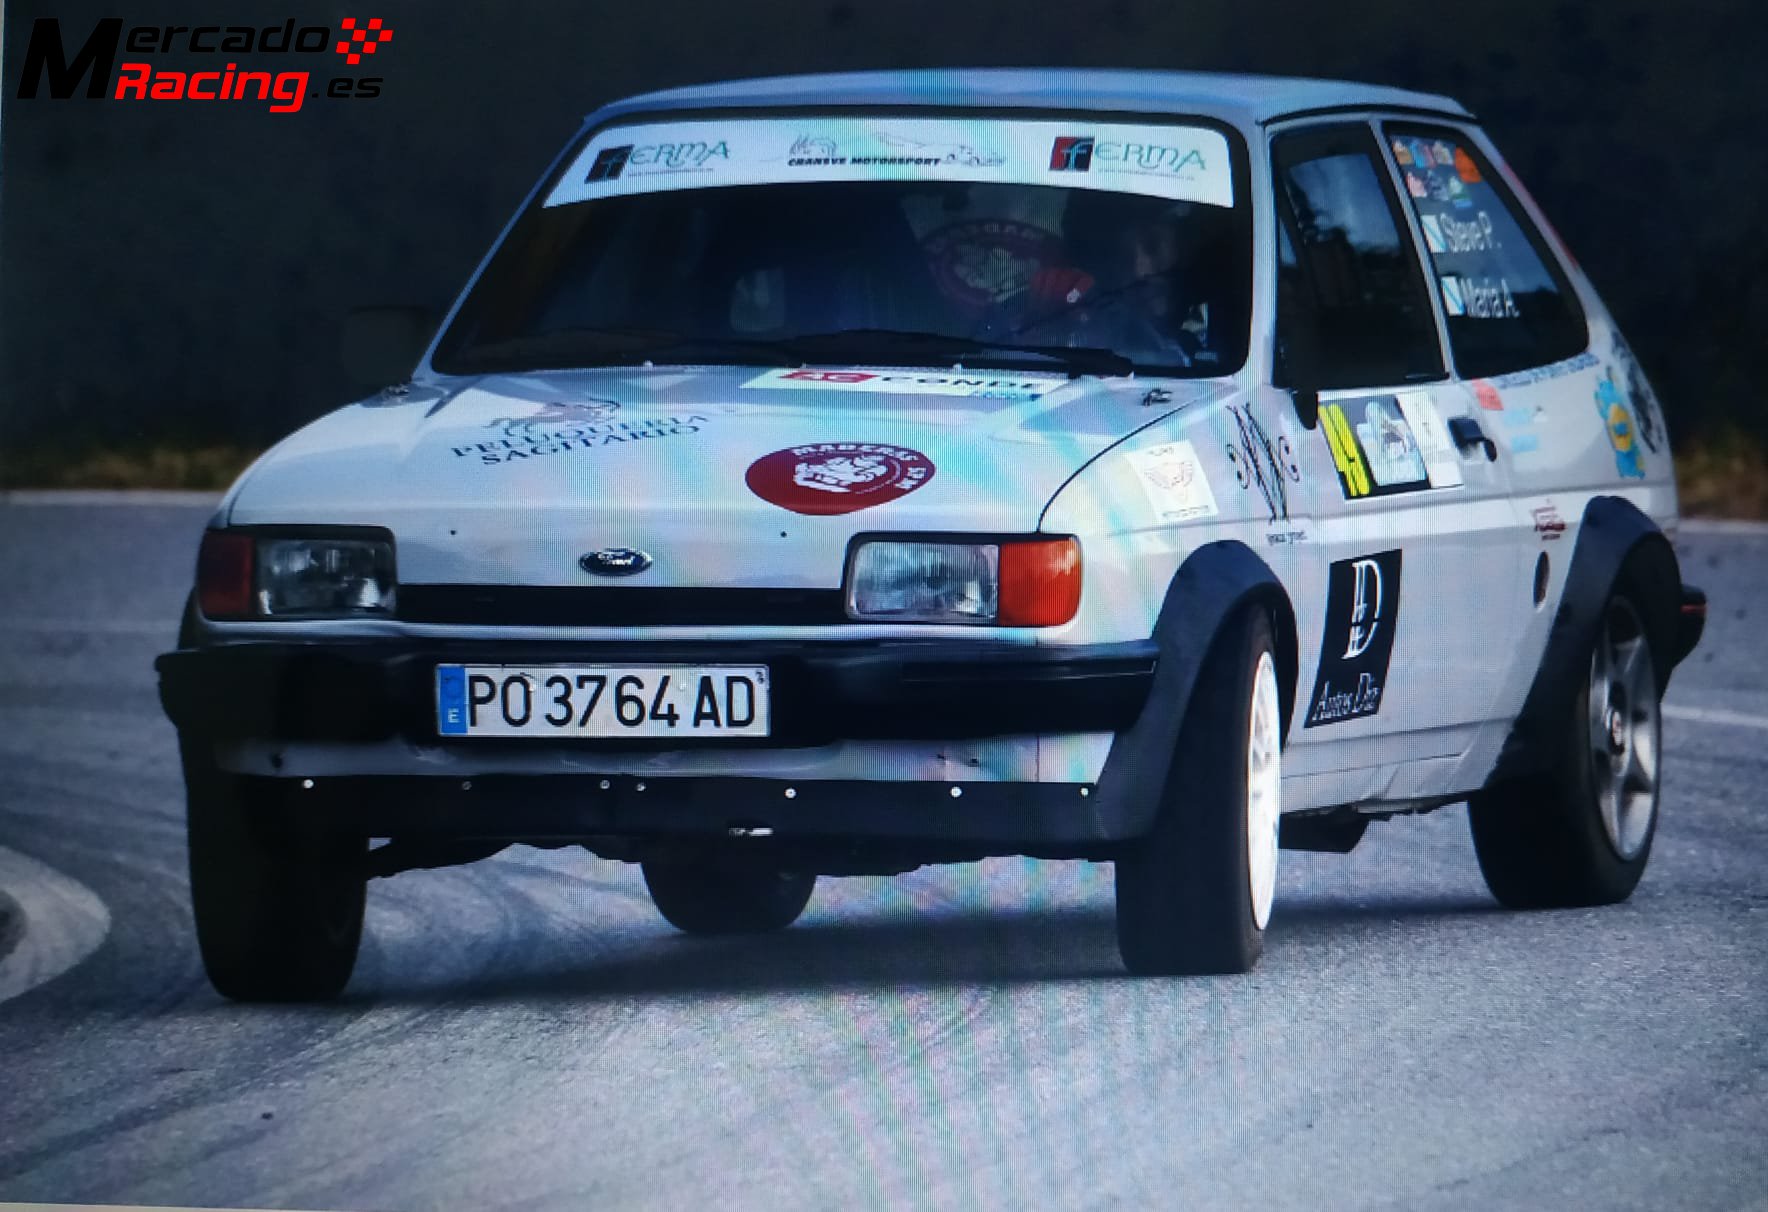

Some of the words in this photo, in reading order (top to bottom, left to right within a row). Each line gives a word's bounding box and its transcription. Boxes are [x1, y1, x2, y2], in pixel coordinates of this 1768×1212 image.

[851, 156, 942, 166] MOTORSPORT
[545, 675, 680, 727] 3764
[693, 675, 756, 727] AD
[447, 708, 460, 724] E
